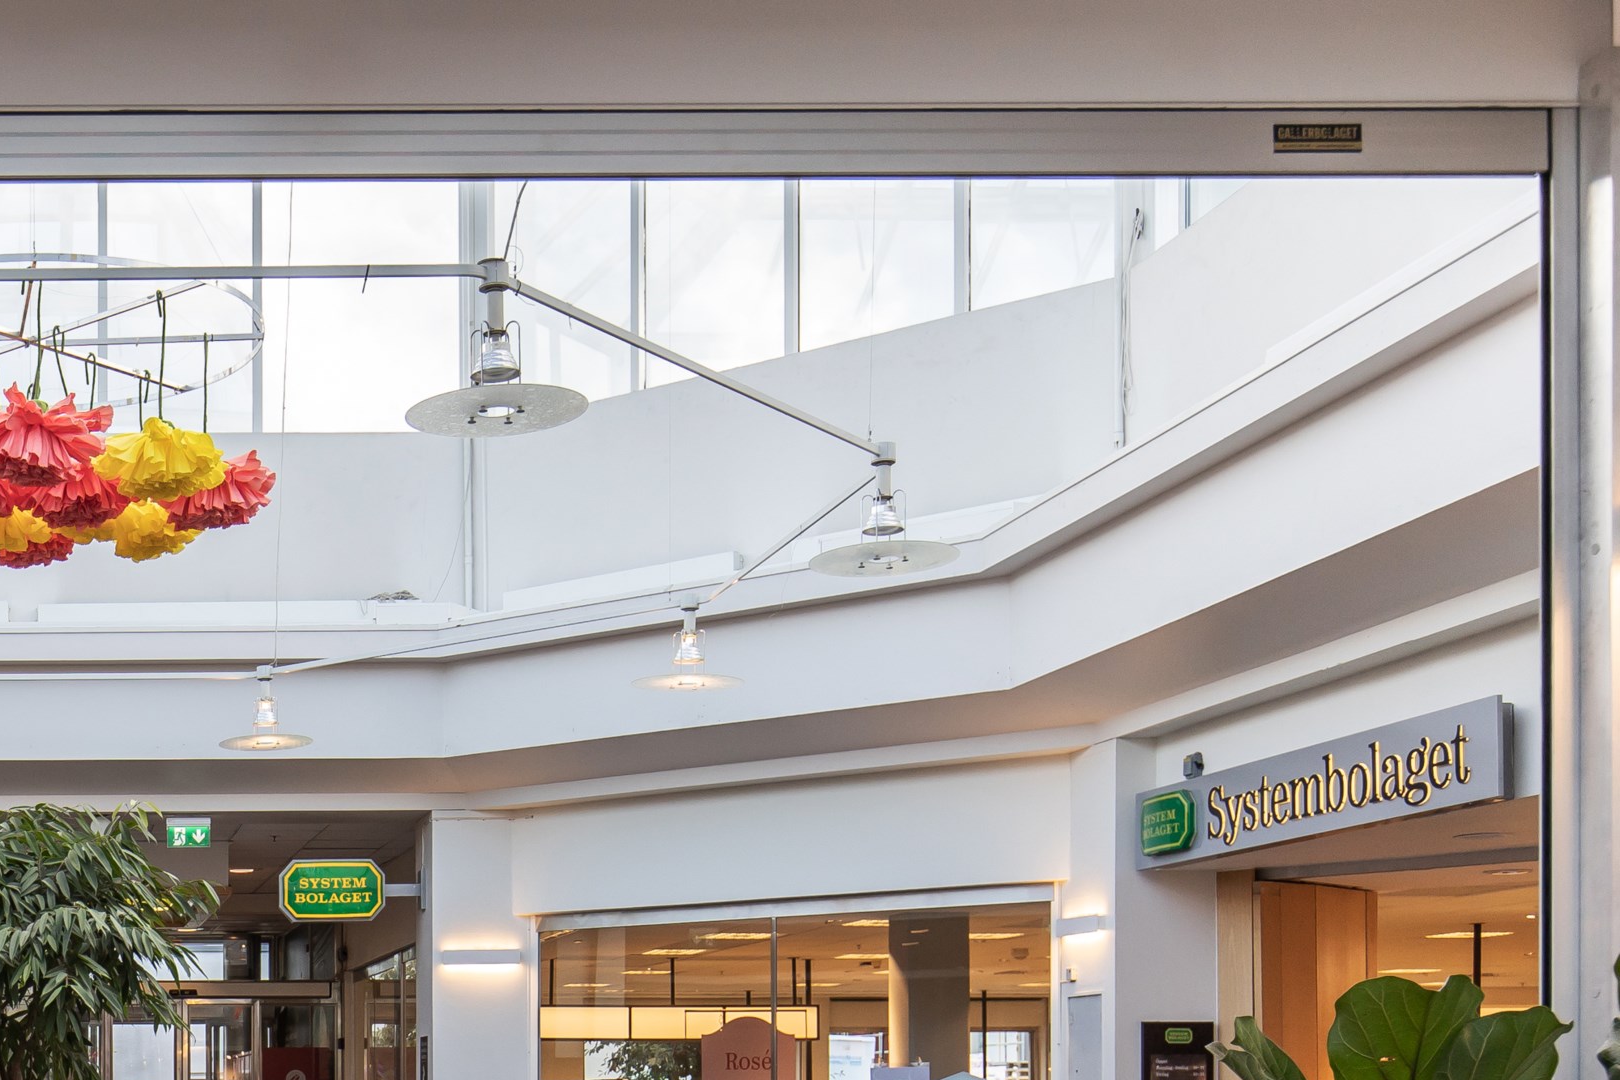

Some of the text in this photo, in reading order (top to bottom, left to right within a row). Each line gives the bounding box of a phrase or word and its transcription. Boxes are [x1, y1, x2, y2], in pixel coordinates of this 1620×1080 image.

[1207, 723, 1472, 845] Systembolaget
[299, 877, 367, 889] SYSTEM
[294, 892, 372, 904] BOLAGET
[725, 1049, 772, 1070] Rosé
